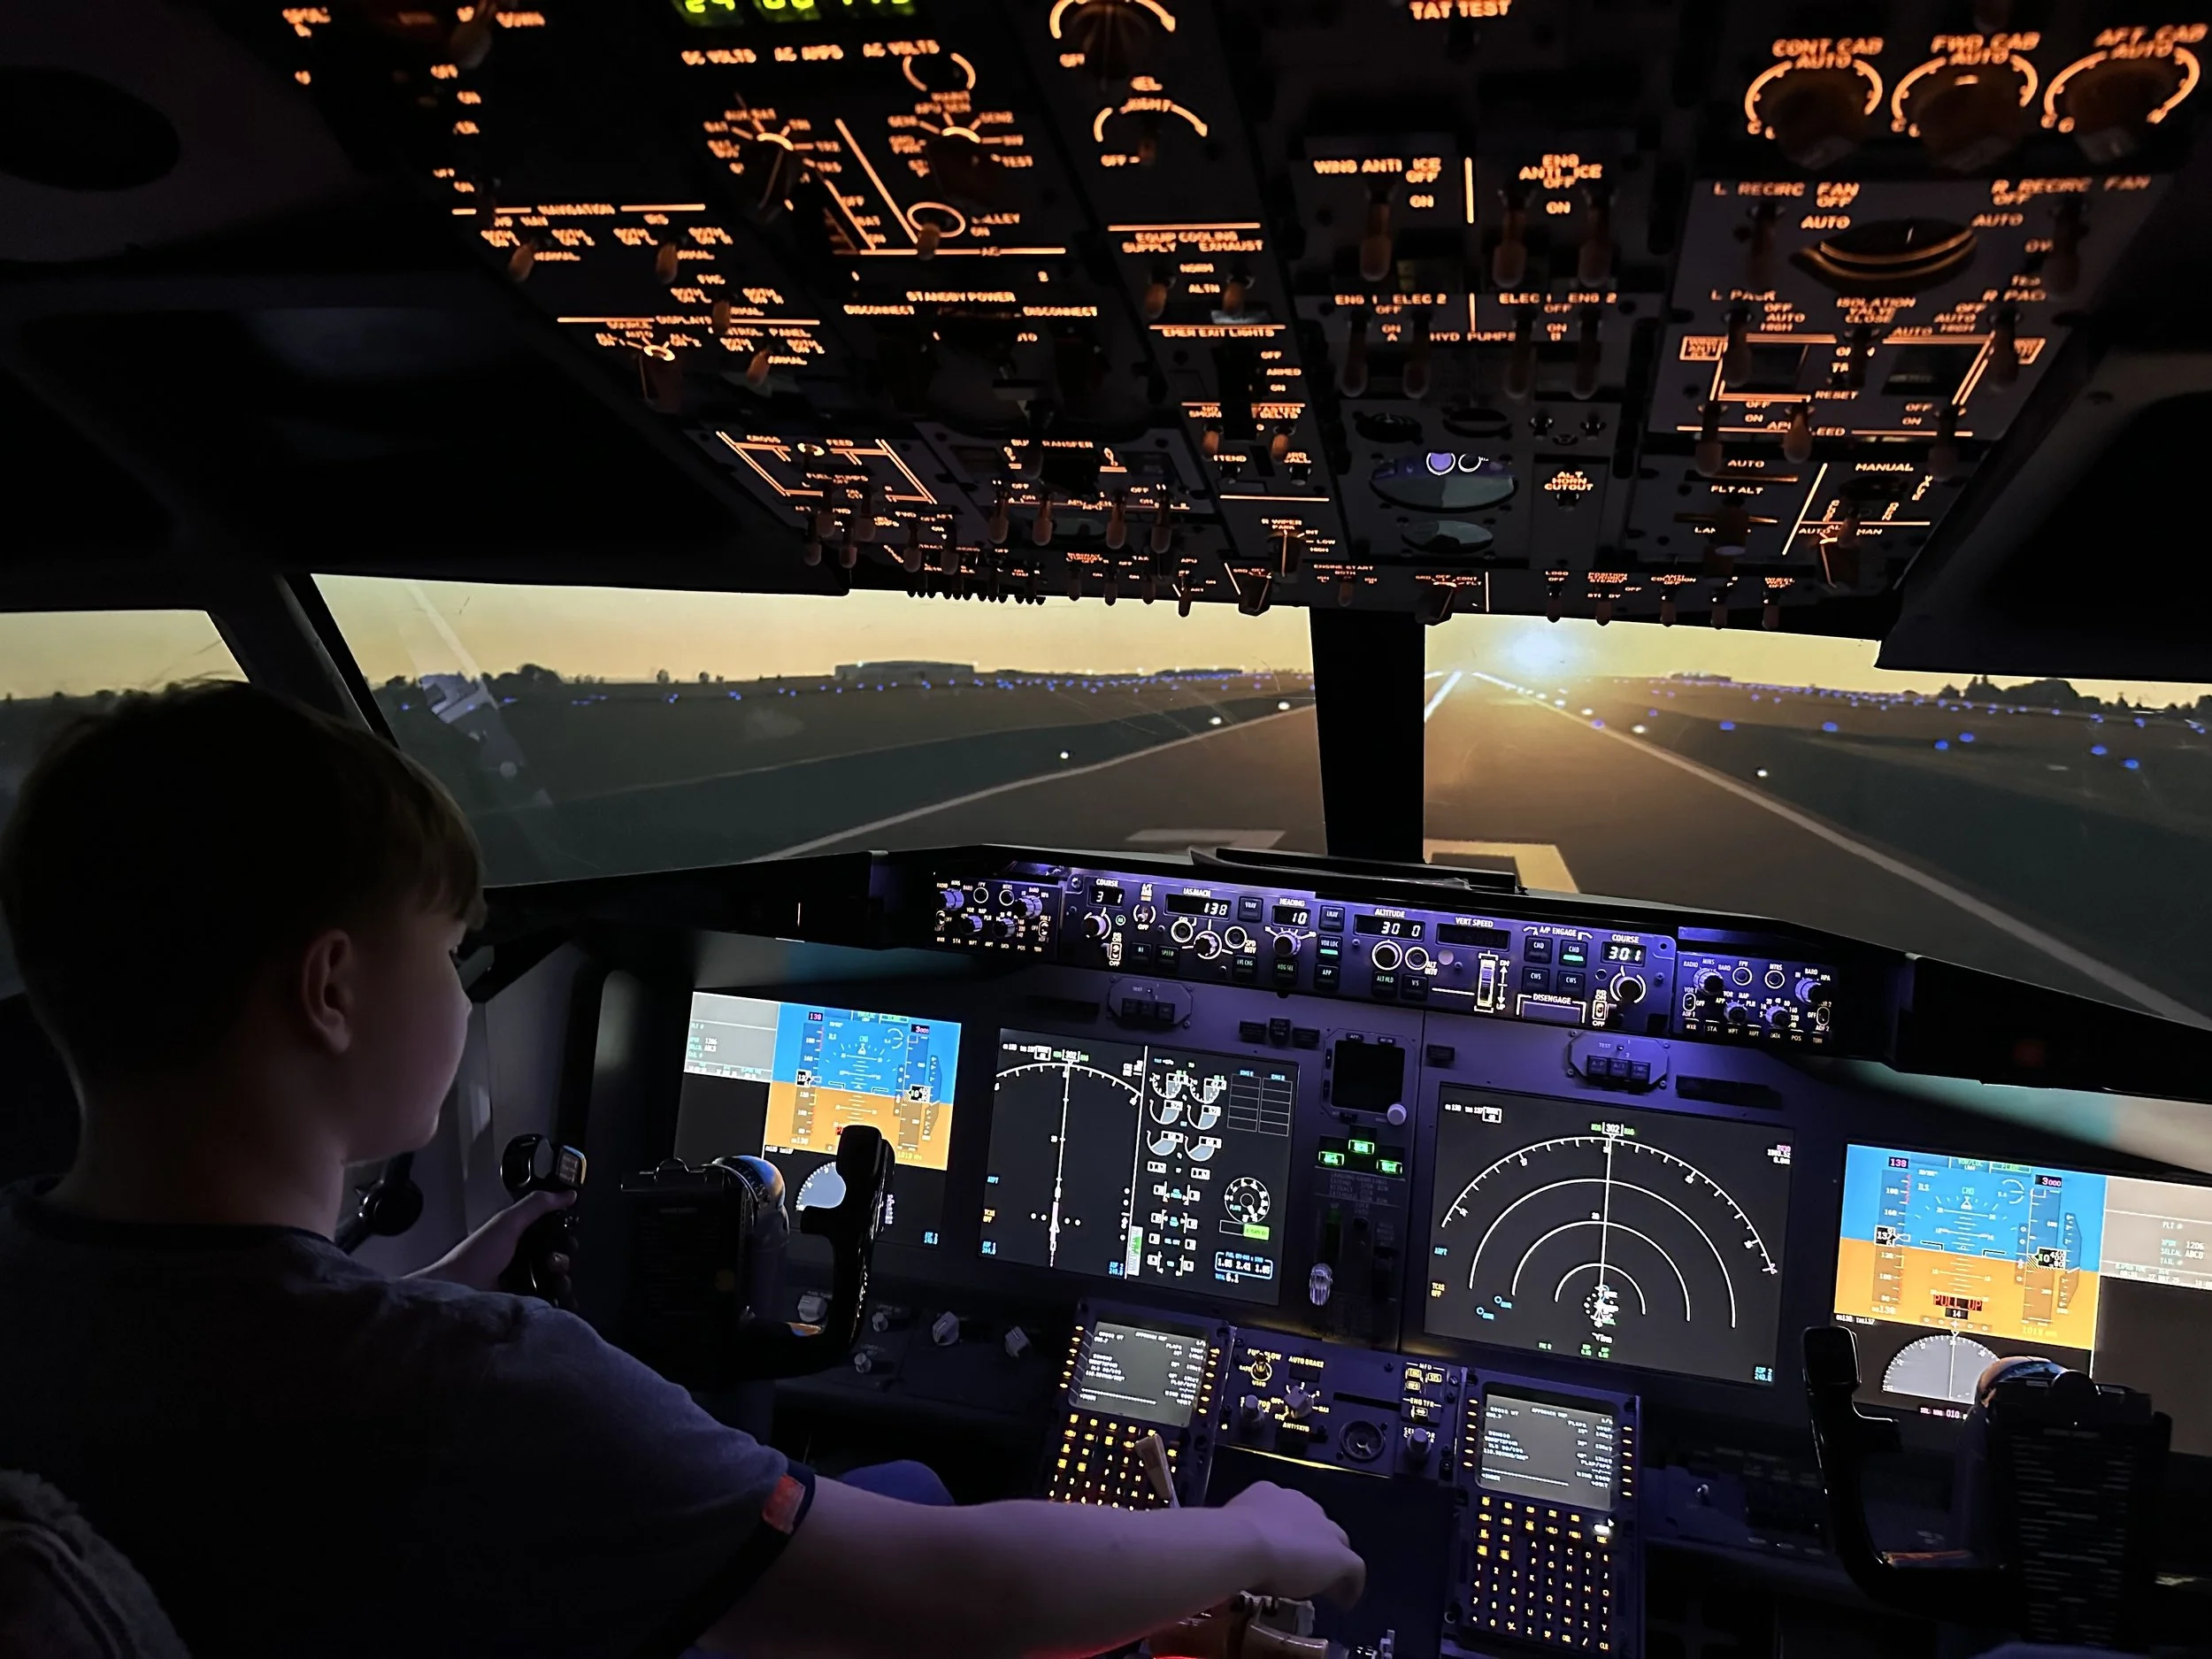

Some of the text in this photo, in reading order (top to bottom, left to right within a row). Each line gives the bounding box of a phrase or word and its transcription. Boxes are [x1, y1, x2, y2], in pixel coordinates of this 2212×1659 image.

[1411, 0, 1509, 19] TAT TEST
[2155, 24, 2208, 42] CAB
[1772, 37, 1884, 56] CONT CAB
[1932, 33, 2040, 53] FWD CAB
[2111, 42, 2174, 59] AUTO
[1795, 55, 1852, 69] AUTO
[1950, 50, 2008, 65] AUTO
[1314, 157, 1440, 173] WING ANTI ICE
[1543, 154, 1578, 167] ENG
[1406, 171, 1439, 183] OFF
[1738, 182, 1804, 196] RECIRC
[1817, 183, 1859, 196] FAN
[2019, 179, 2091, 193] RECIRC
[2104, 176, 2150, 189] FAN
[1409, 196, 1433, 207] ON
[1816, 196, 1851, 208] OFF
[1993, 194, 2029, 206] OFF
[1547, 202, 1571, 214] ON
[1801, 216, 1850, 229] AUTO
[1972, 213, 2024, 227] AUTO
[1335, 295, 1364, 304] ENG
[1393, 294, 1432, 303] ELEC
[1437, 294, 1447, 303] 2
[1500, 294, 1540, 303] ELEC
[1568, 294, 1600, 303] ENG
[1606, 294, 1617, 303] 2
[1711, 290, 1722, 300] L
[1764, 303, 1791, 312] OFF
[1837, 298, 1916, 308] ISOLATION
[1955, 303, 1985, 313] OFF
[1544, 304, 1571, 313] OFF
[1766, 313, 1805, 323] AUTO
[1934, 313, 1976, 323] AUTO
[1548, 324, 1567, 333] ON
[1761, 323, 1793, 332] HIGH
[1892, 326, 1933, 336] AUTO
[1430, 332, 1516, 342] HYD PUMPS
[1815, 391, 1857, 400] RESET
[1728, 459, 1764, 468] AUTO
[1279, 898, 1305, 907] HEADING
[1203, 902, 1228, 915] 138
[1375, 909, 1405, 918] ALTITUDE
[1381, 922, 1400, 934] 30
[1472, 918, 1494, 928] SPEED
[1612, 933, 1639, 943] COURSE
[1609, 947, 1640, 961] 301
[1532, 994, 1571, 1004] DISENGAGE
[1606, 1124, 1619, 1133] 302
[1891, 1158, 1907, 1167] 138
[1933, 1295, 1982, 1309] PULL UP
